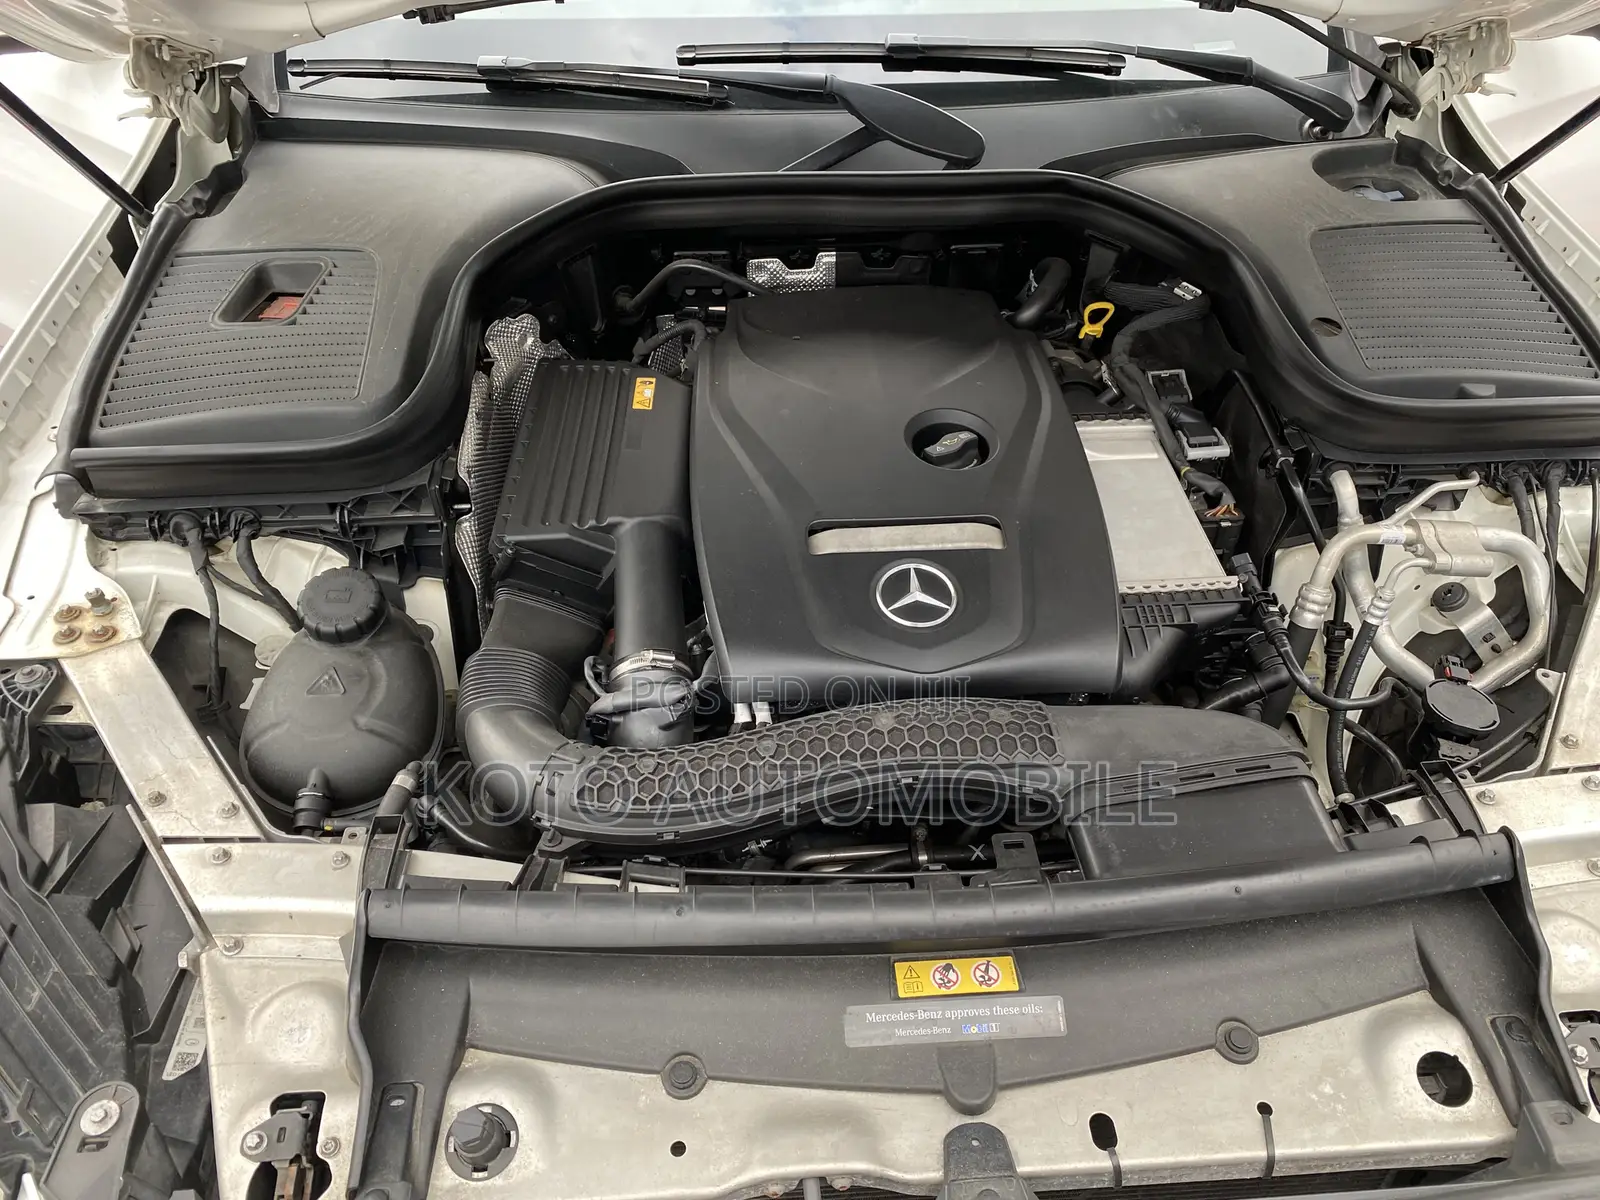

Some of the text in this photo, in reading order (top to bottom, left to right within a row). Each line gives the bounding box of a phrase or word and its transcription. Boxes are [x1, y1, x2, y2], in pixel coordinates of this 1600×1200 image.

[865, 1004, 1043, 1023] Mercedes-Benz approves these oils:
[895, 1026, 951, 1037] Mercedes-Benz
[962, 1023, 989, 1034] Mobil
